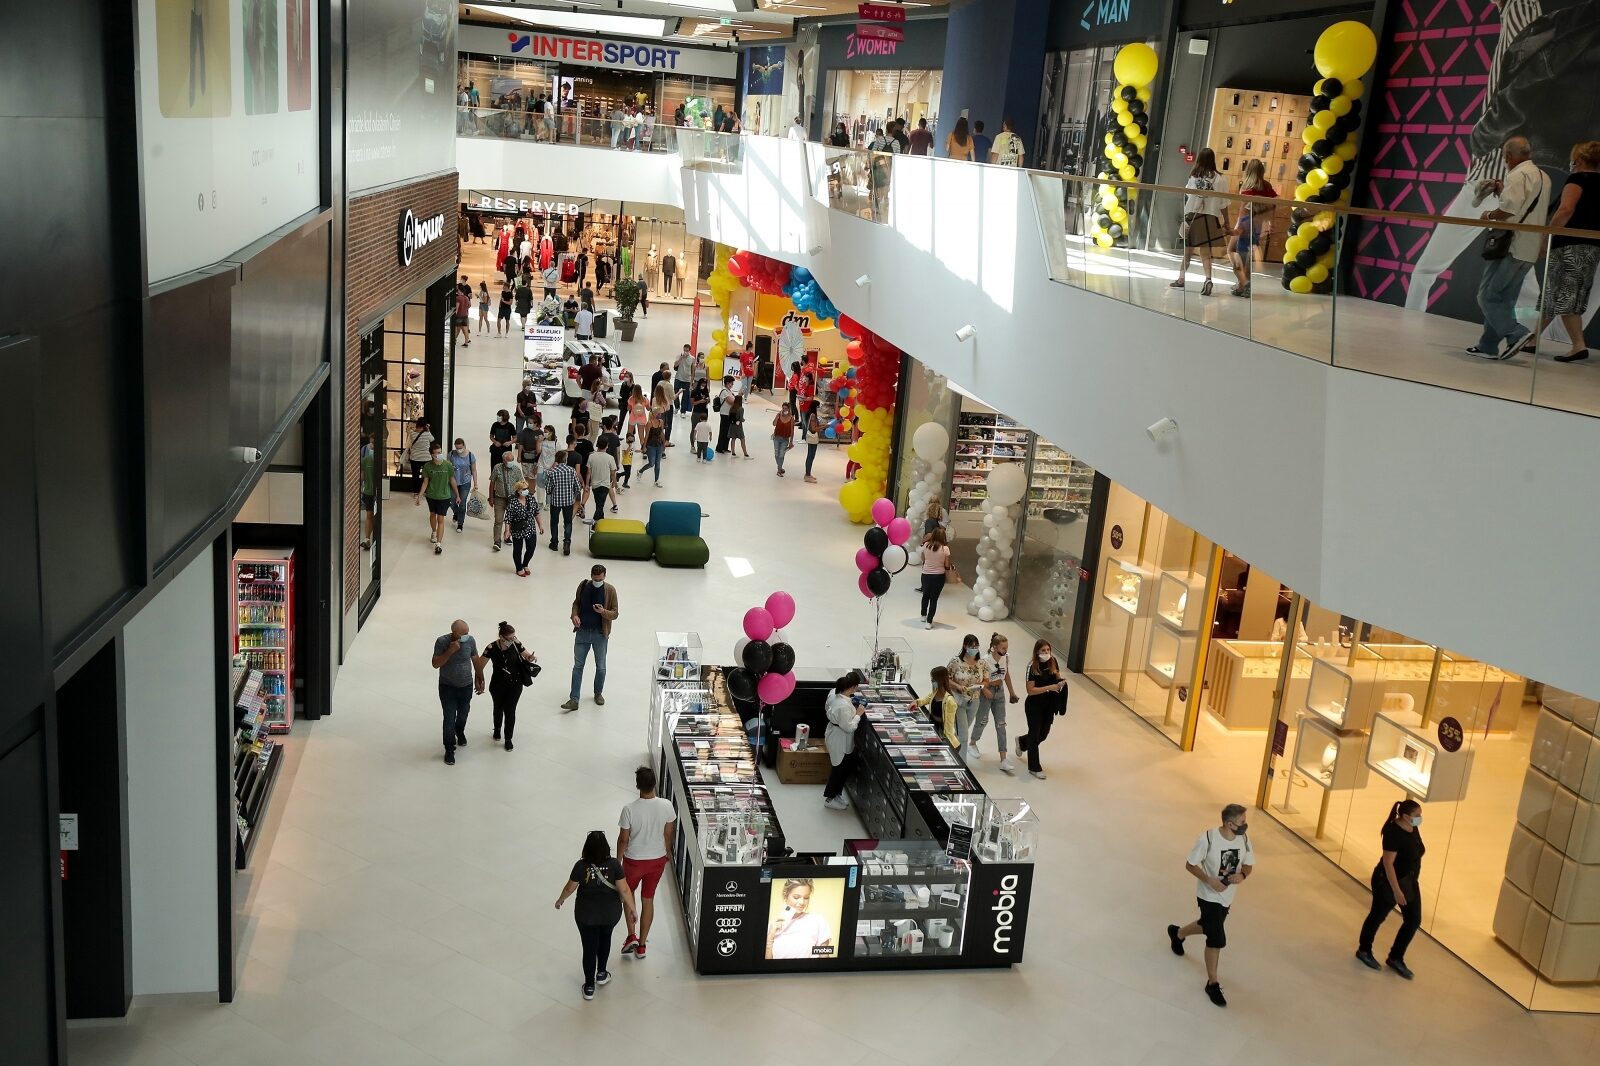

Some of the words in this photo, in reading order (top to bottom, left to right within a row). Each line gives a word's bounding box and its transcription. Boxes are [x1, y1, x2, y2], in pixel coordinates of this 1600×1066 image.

[1096, 0, 1131, 25] MAN
[533, 35, 681, 70] INTERSPORT
[856, 38, 897, 55] WOMEN
[481, 197, 579, 216] RESERVED
[414, 213, 445, 250] house
[782, 311, 809, 328] dm
[728, 366, 742, 376] dm
[1441, 722, 1462, 742] 35%
[715, 904, 746, 912] Ferrari
[991, 874, 1019, 953] mobia
